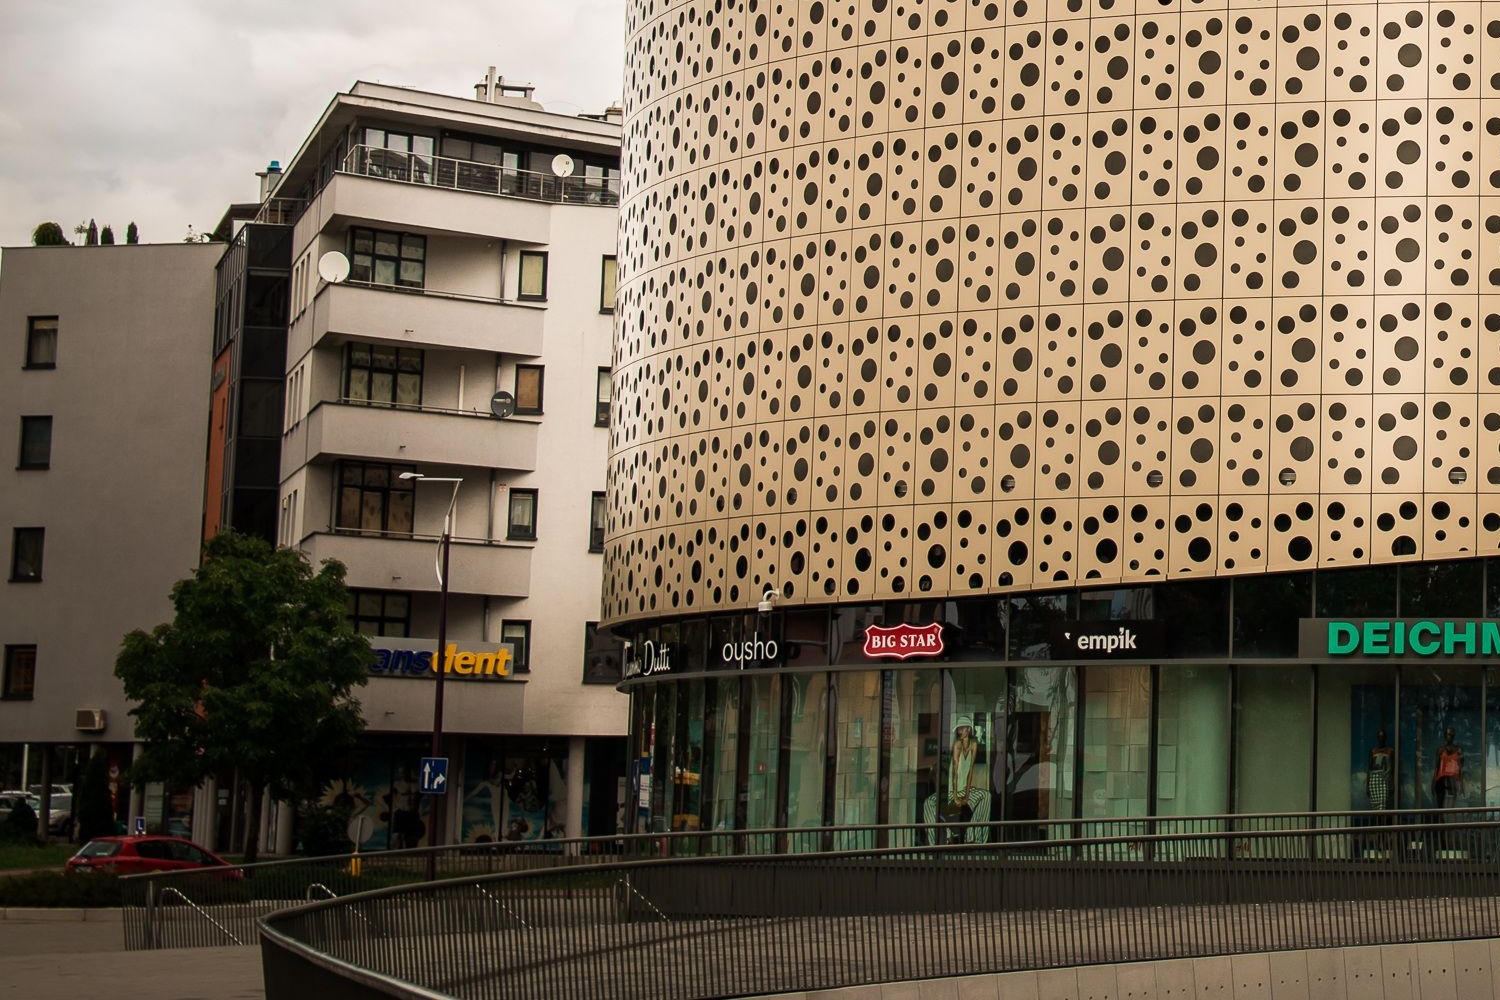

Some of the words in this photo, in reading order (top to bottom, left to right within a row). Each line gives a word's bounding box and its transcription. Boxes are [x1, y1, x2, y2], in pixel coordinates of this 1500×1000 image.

[722, 631, 778, 671] oysho
[871, 634, 896, 649] BIG
[899, 633, 936, 648] STAR
[1077, 626, 1137, 653] empik
[368, 643, 513, 678] ansdent
[642, 639, 671, 676] Dutti
